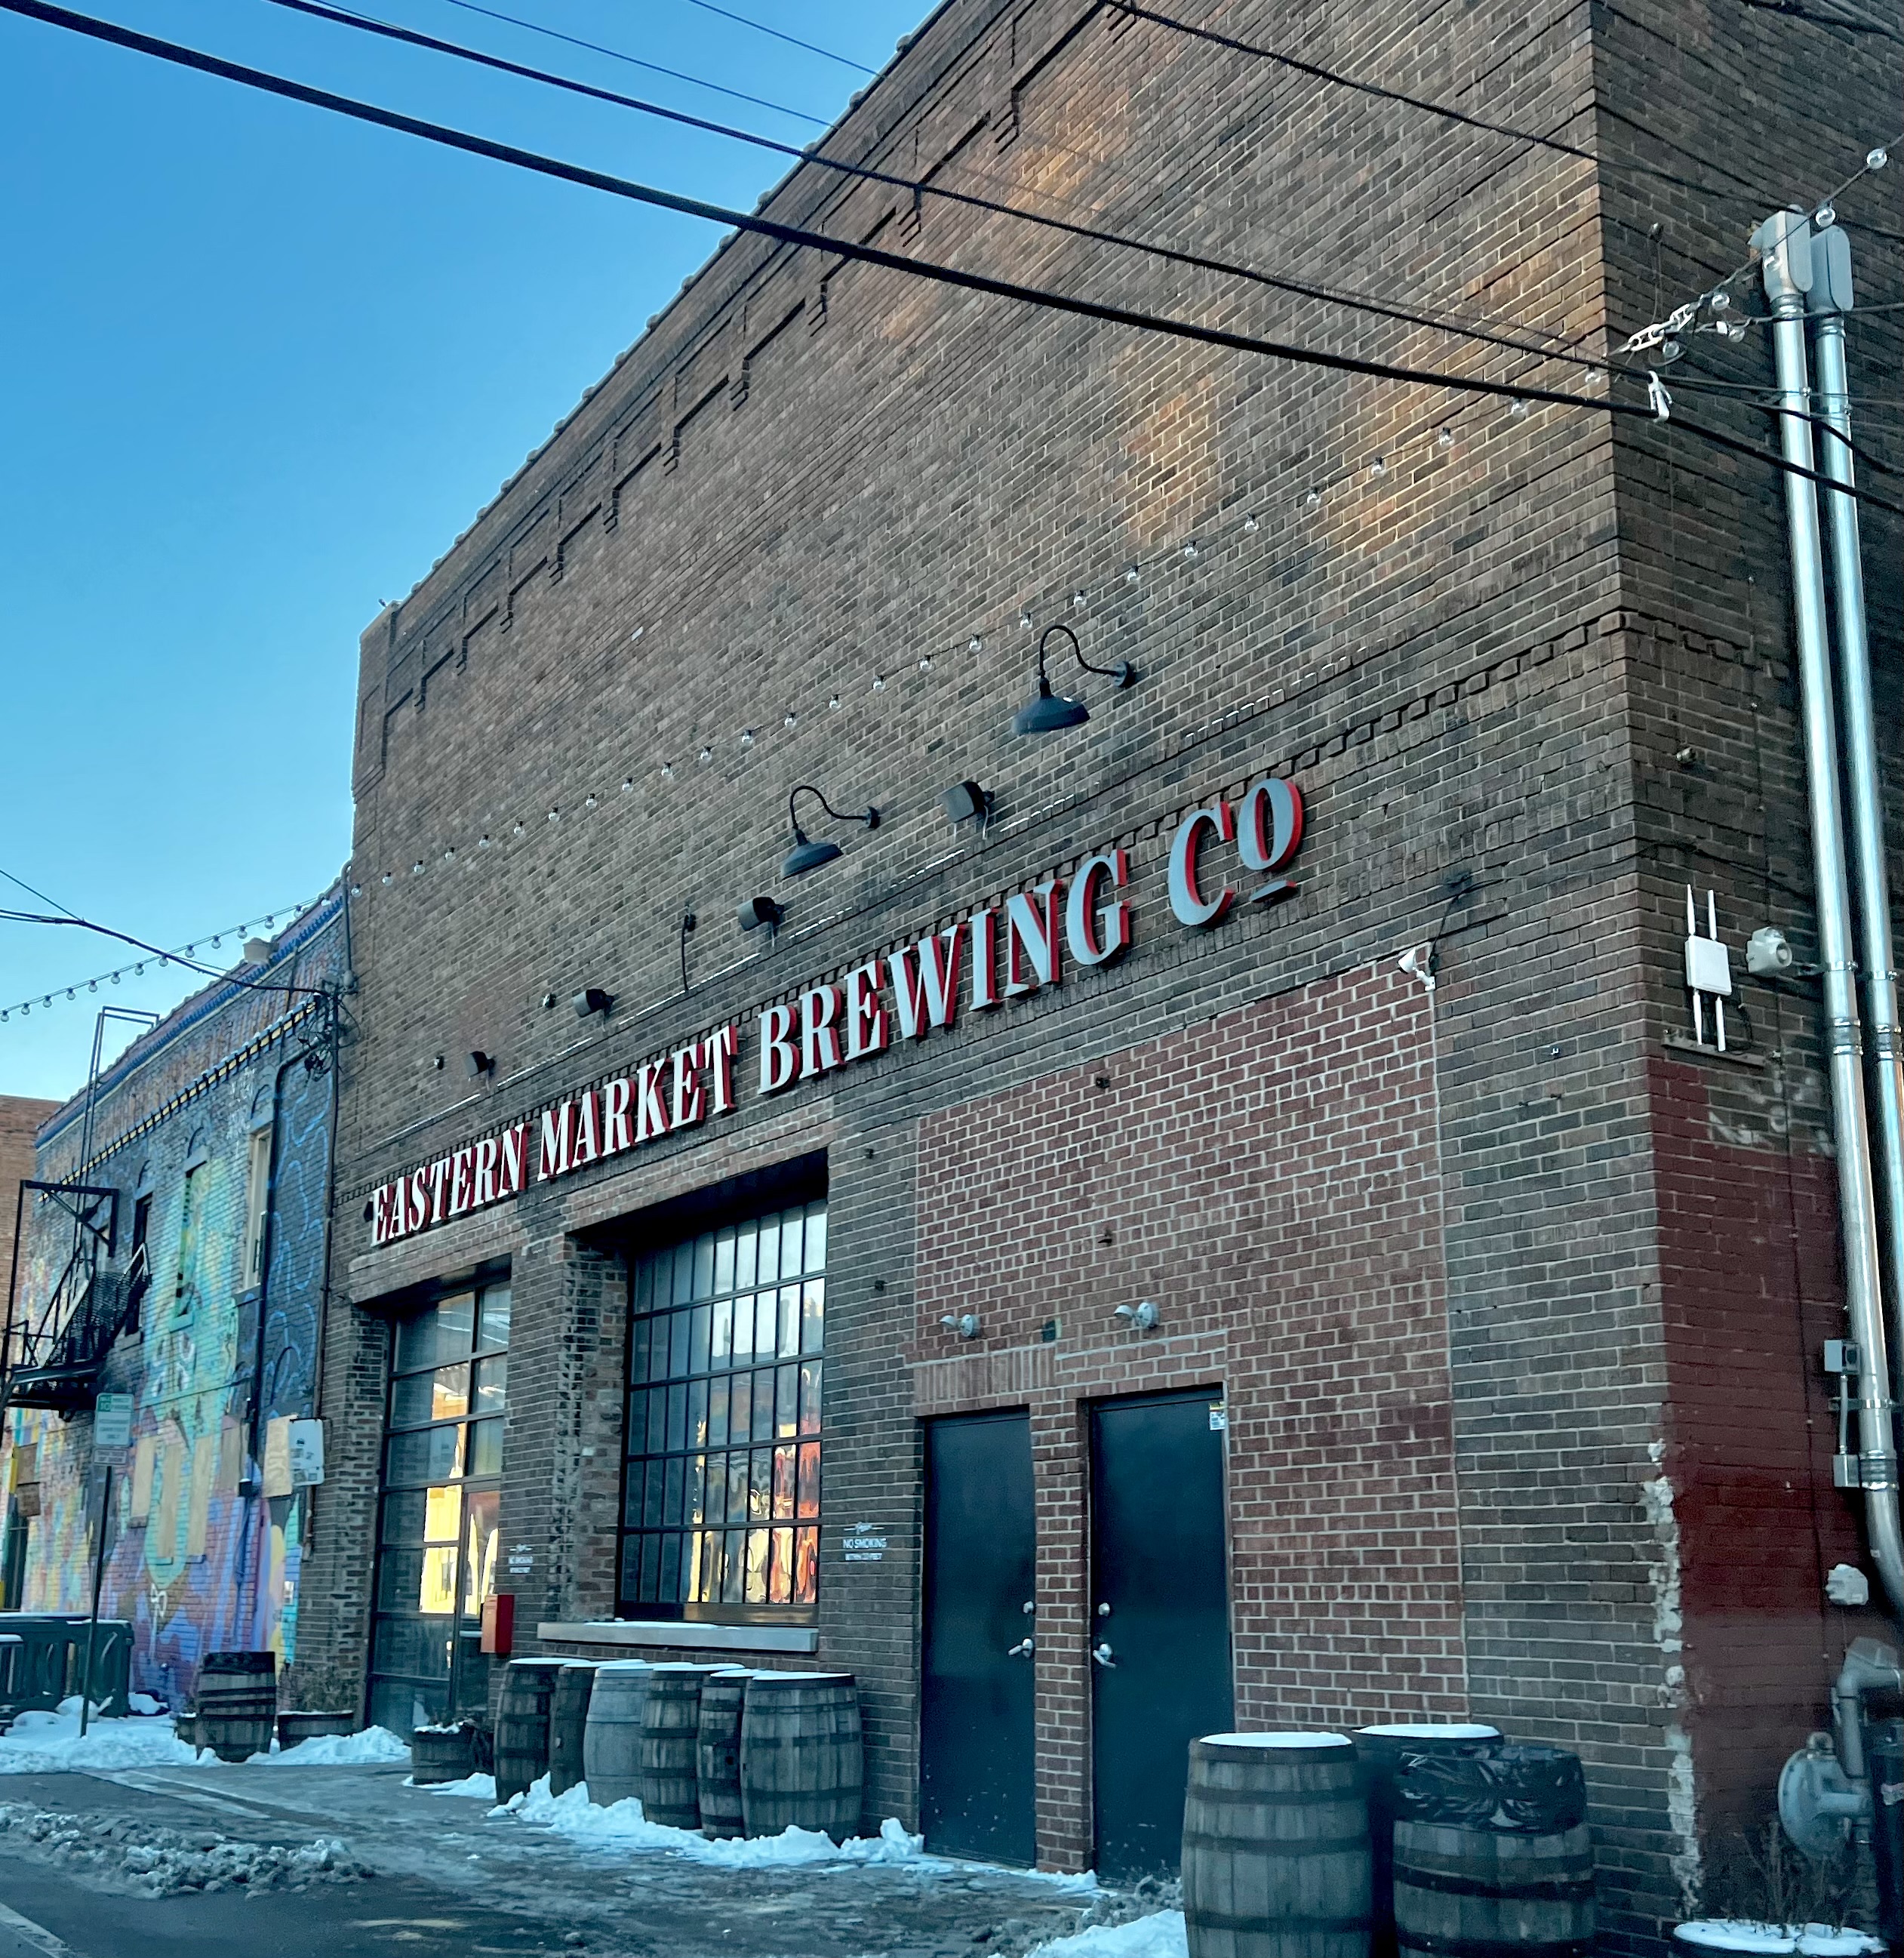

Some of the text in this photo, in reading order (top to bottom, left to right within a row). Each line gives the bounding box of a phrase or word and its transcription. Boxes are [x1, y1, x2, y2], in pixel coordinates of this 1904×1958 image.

[371, 1122, 531, 1248] EASTERN
[537, 1025, 738, 1182] MARKET
[757, 848, 1130, 1095] BREWING
